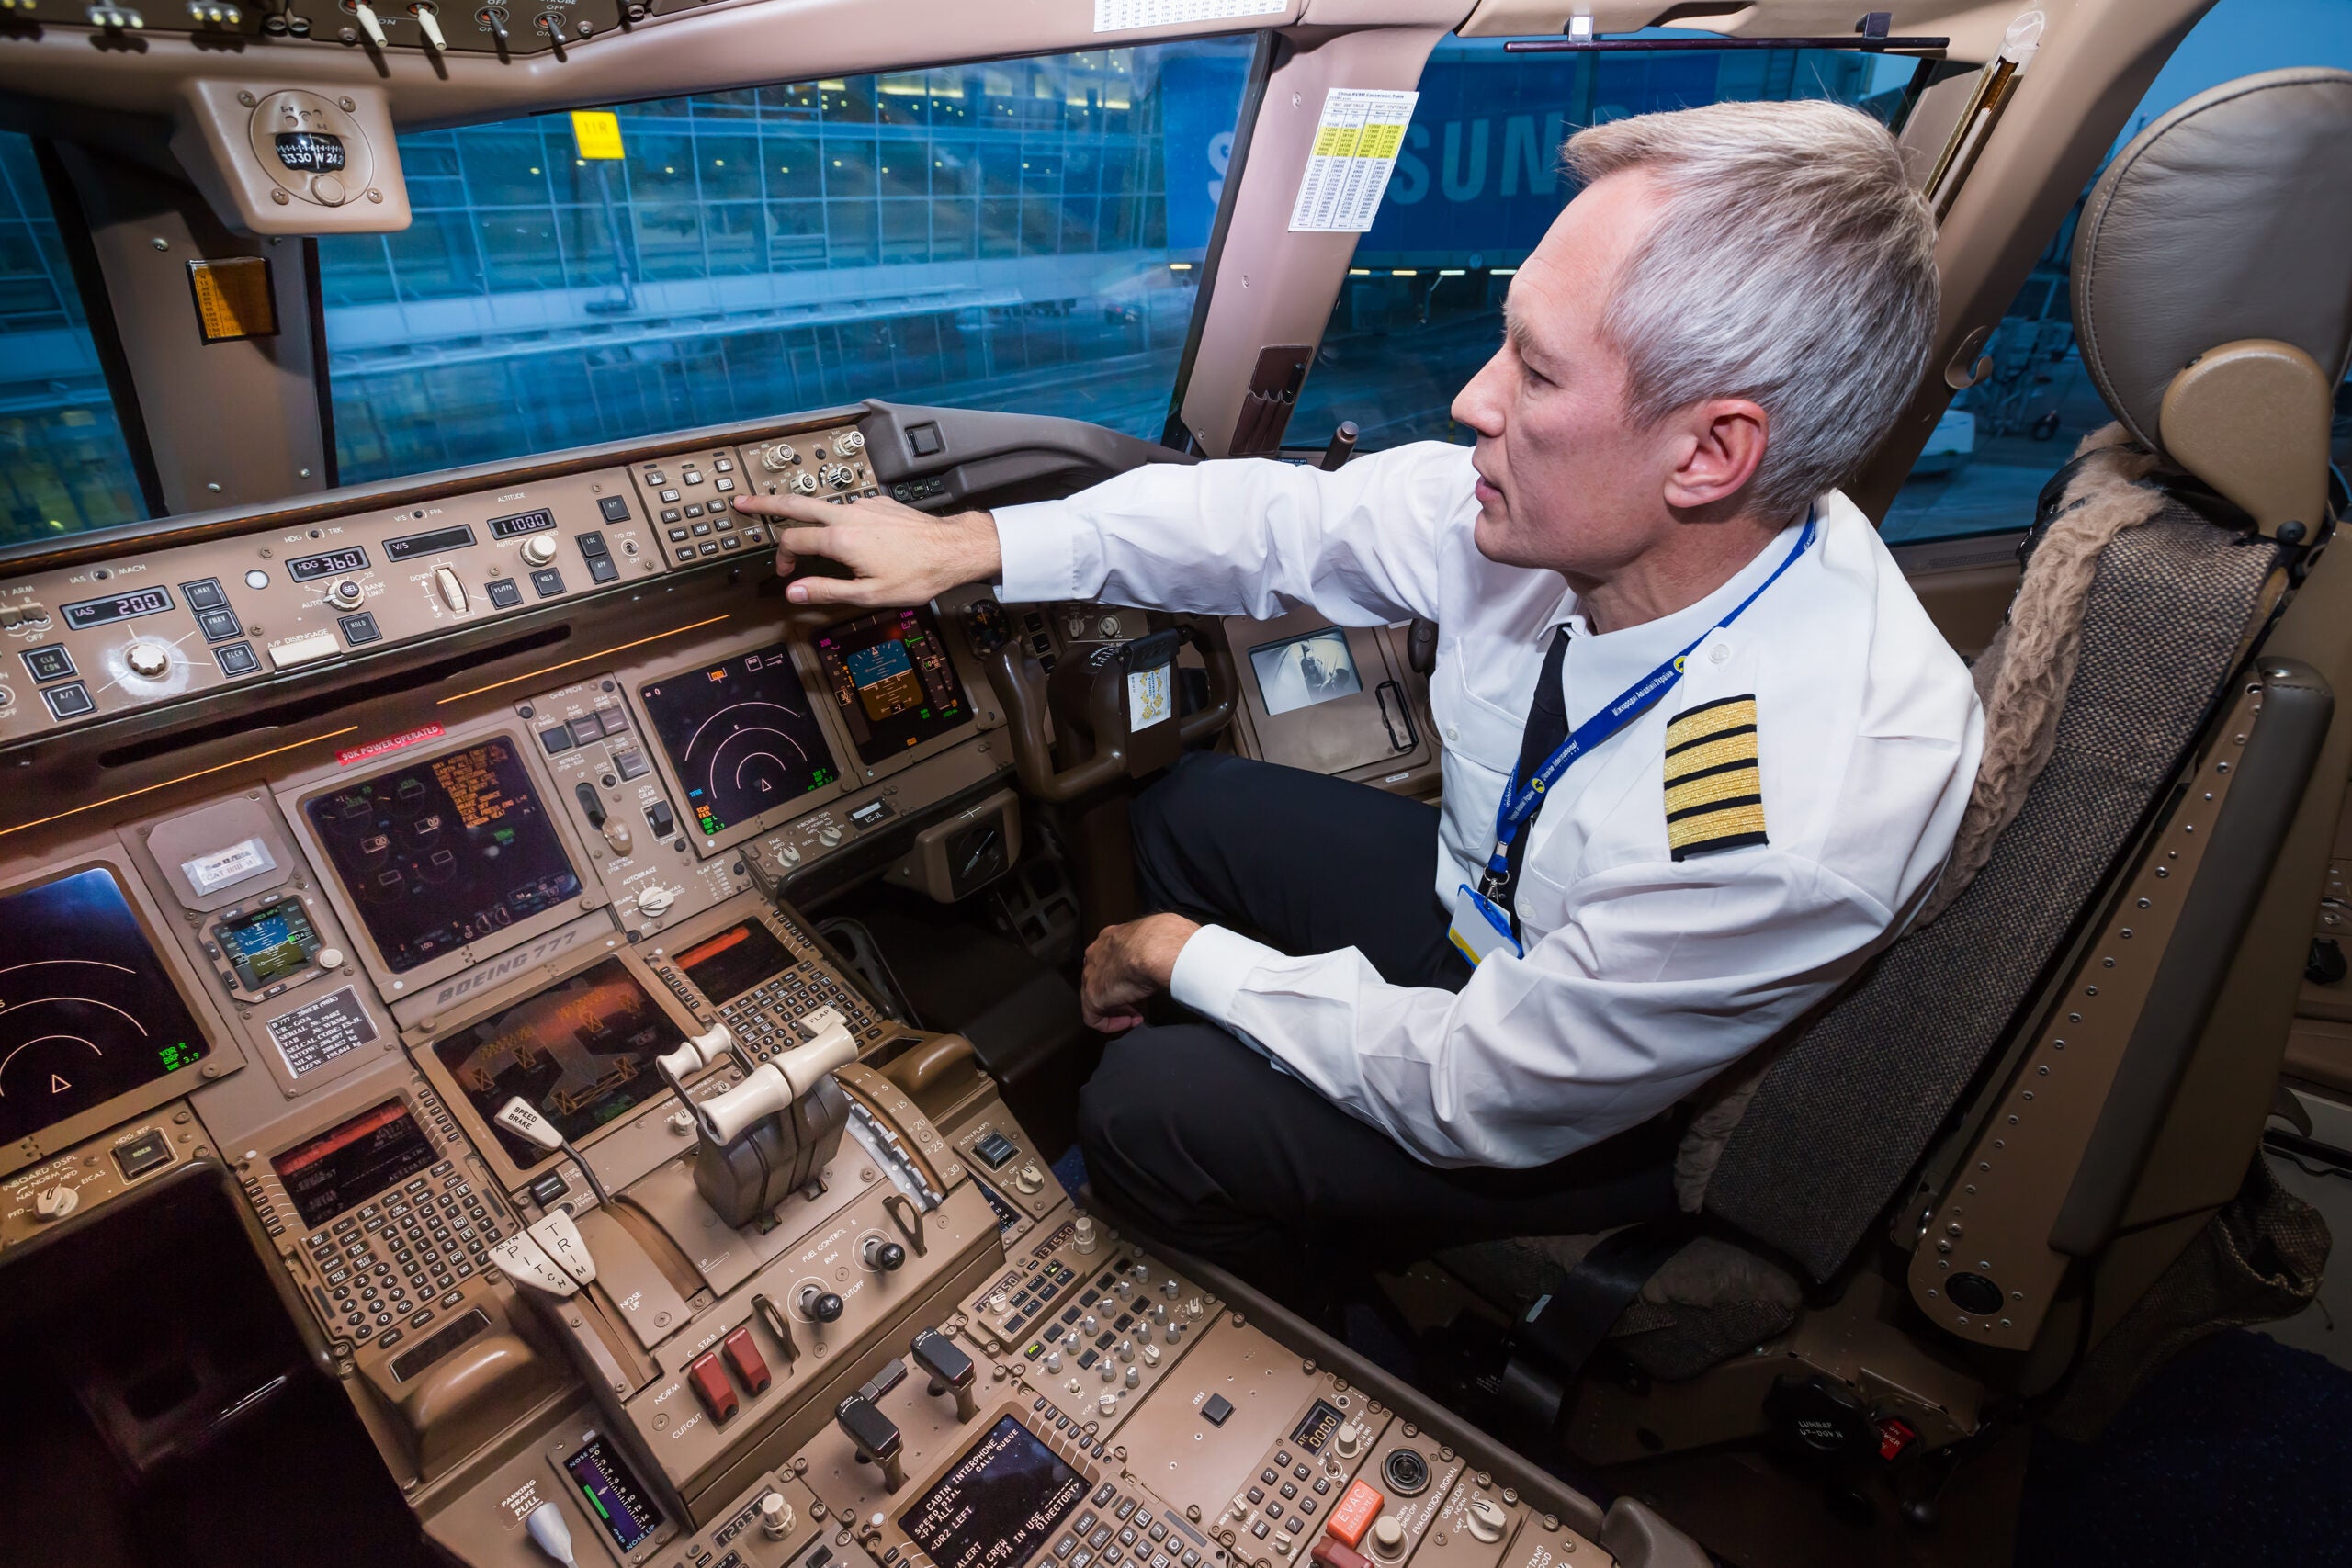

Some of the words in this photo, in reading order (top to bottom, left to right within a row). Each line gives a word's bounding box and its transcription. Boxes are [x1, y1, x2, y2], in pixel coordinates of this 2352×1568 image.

[298, 153, 311, 163] 30
[497, 492, 526, 503] ALTITUDE
[284, 535, 303, 543] HDG
[496, 539, 514, 548] AUTO
[297, 561, 319, 571] HDG
[322, 553, 358, 572] 360
[69, 575, 86, 584] IAS
[119, 564, 147, 575] MACH
[410, 572, 434, 582] DOWN
[13, 585, 35, 594] ARM
[365, 582, 387, 591] BANK
[368, 589, 385, 597] LIMIT
[74, 607, 96, 617] IAS
[116, 594, 161, 615] 200
[301, 600, 322, 609] AUTO
[351, 620, 366, 628] HOLD
[26, 633, 46, 643] OFF
[285, 629, 329, 645] DISENGAGE
[342, 750, 359, 761] 90K
[360, 739, 393, 755] POWER
[395, 725, 439, 744] OPERATED
[622, 866, 657, 886] AUTOBRAKE
[436, 952, 527, 1006] BOEING
[533, 930, 578, 959] 777
[279, 1017, 290, 1025] 777
[293, 1017, 311, 1027] GOA
[808, 1010, 830, 1023] FLAP
[278, 1026, 308, 1041] SERIAL
[283, 1037, 300, 1047] TAB
[286, 1038, 317, 1054] SELCAL
[882, 1083, 889, 1091] 5
[896, 1100, 908, 1110] 15
[507, 1113, 533, 1131] BRAKE
[514, 1106, 537, 1122] SPEED
[913, 1119, 926, 1130] 20
[959, 1134, 974, 1147] ALTN
[972, 1122, 990, 1137] FLAPS
[930, 1140, 944, 1153] 25
[2, 1168, 50, 1191] INBOARD
[53, 1155, 78, 1168] DSPL
[60, 1169, 78, 1181] MFD
[81, 1169, 107, 1185] EICAS
[947, 1164, 960, 1175] 30
[31, 1172, 60, 1187] NORM
[16, 1190, 36, 1202] NAV
[7, 1208, 25, 1219] PFD
[495, 1235, 519, 1253] ALTN
[545, 1223, 586, 1276] TRIM
[801, 1249, 818, 1264] FUEL
[817, 1227, 847, 1251] CONTROL
[823, 1251, 839, 1265] RUN
[507, 1246, 567, 1289] PITCH
[841, 1280, 865, 1302] CUTOFF
[620, 1290, 642, 1310] NOSE
[629, 1301, 640, 1313] UP
[697, 1334, 717, 1350] STAB
[654, 1382, 680, 1405] NORM
[673, 1412, 703, 1439] CUTOUT
[1309, 1416, 1337, 1448] 0000
[1297, 1435, 1308, 1446] ATC
[569, 1451, 589, 1468] NOSE
[589, 1443, 600, 1454] DN
[975, 1453, 994, 1473] CALL
[996, 1428, 1019, 1451] QUEUE
[926, 1484, 953, 1512] CABIN
[953, 1438, 997, 1485] INTERPHONE
[1266, 1471, 1274, 1479] 2
[502, 1479, 537, 1507] PARKING
[510, 1488, 536, 1508] BRAKE
[627, 1495, 636, 1503] 10
[1412, 1491, 1442, 1535] EVACUATION
[1440, 1467, 1458, 1490] SIGNAL
[1442, 1506, 1453, 1519] OBS
[1452, 1483, 1465, 1506] AUDIO
[1471, 1491, 1480, 1500] F/O
[514, 1496, 541, 1517] PULL
[914, 1508, 938, 1535] SPEED
[940, 1488, 961, 1509] DIAL
[1035, 1483, 1080, 1531] DIRECTORY>
[1337, 1488, 1365, 1523] EVAC
[1454, 1497, 1467, 1515] NORM
[938, 1506, 954, 1523] ALL
[1401, 1503, 1419, 1529] SHUTOFF
[930, 1529, 951, 1551] <DR2
[952, 1506, 973, 1529] LEFT
[1453, 1518, 1464, 1533] CAPT
[626, 1532, 645, 1551] NOSE
[645, 1524, 655, 1537] UP
[1001, 1547, 1013, 1558] PA
[1013, 1529, 1027, 1544] IN
[1026, 1511, 1043, 1530] USE
[1527, 1545, 1544, 1568] TAND
